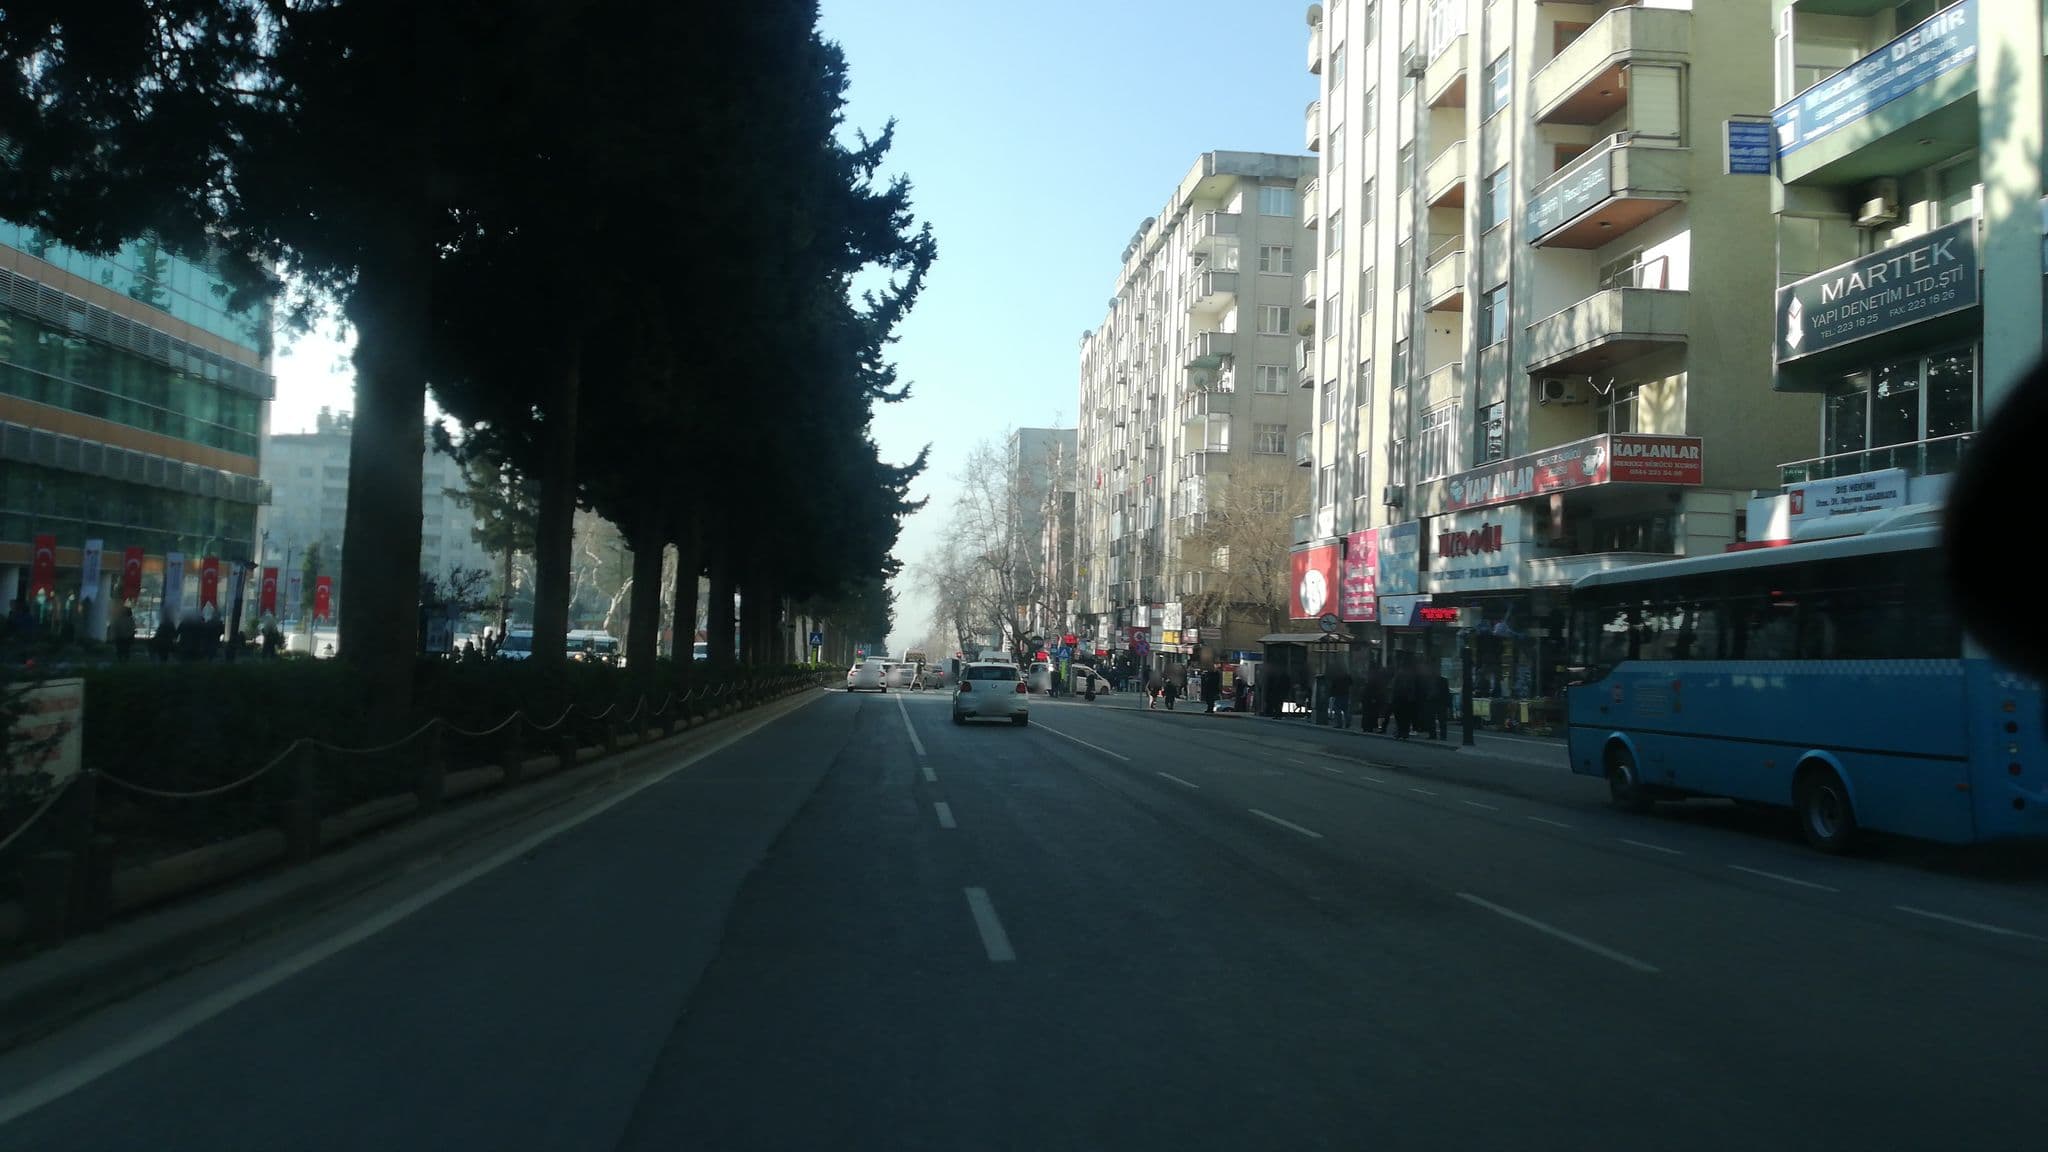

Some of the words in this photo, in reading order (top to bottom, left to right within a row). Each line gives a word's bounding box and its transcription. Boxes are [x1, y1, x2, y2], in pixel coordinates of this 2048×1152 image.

[1891, 9, 1966, 62] DEMİR
[1820, 237, 1957, 305] MARTEK
[1811, 309, 1838, 328] YAPI
[1841, 288, 1902, 320] DENETİM
[1905, 264, 1964, 298] LTD.ŞTİ
[1837, 321, 1854, 334] 223
[1867, 313, 1879, 324] 25
[1907, 298, 1927, 312] 223
[1941, 288, 1956, 301] 26
[1613, 442, 1699, 459] KAPLANLAR
[1465, 465, 1535, 505] KAPLANLAR
